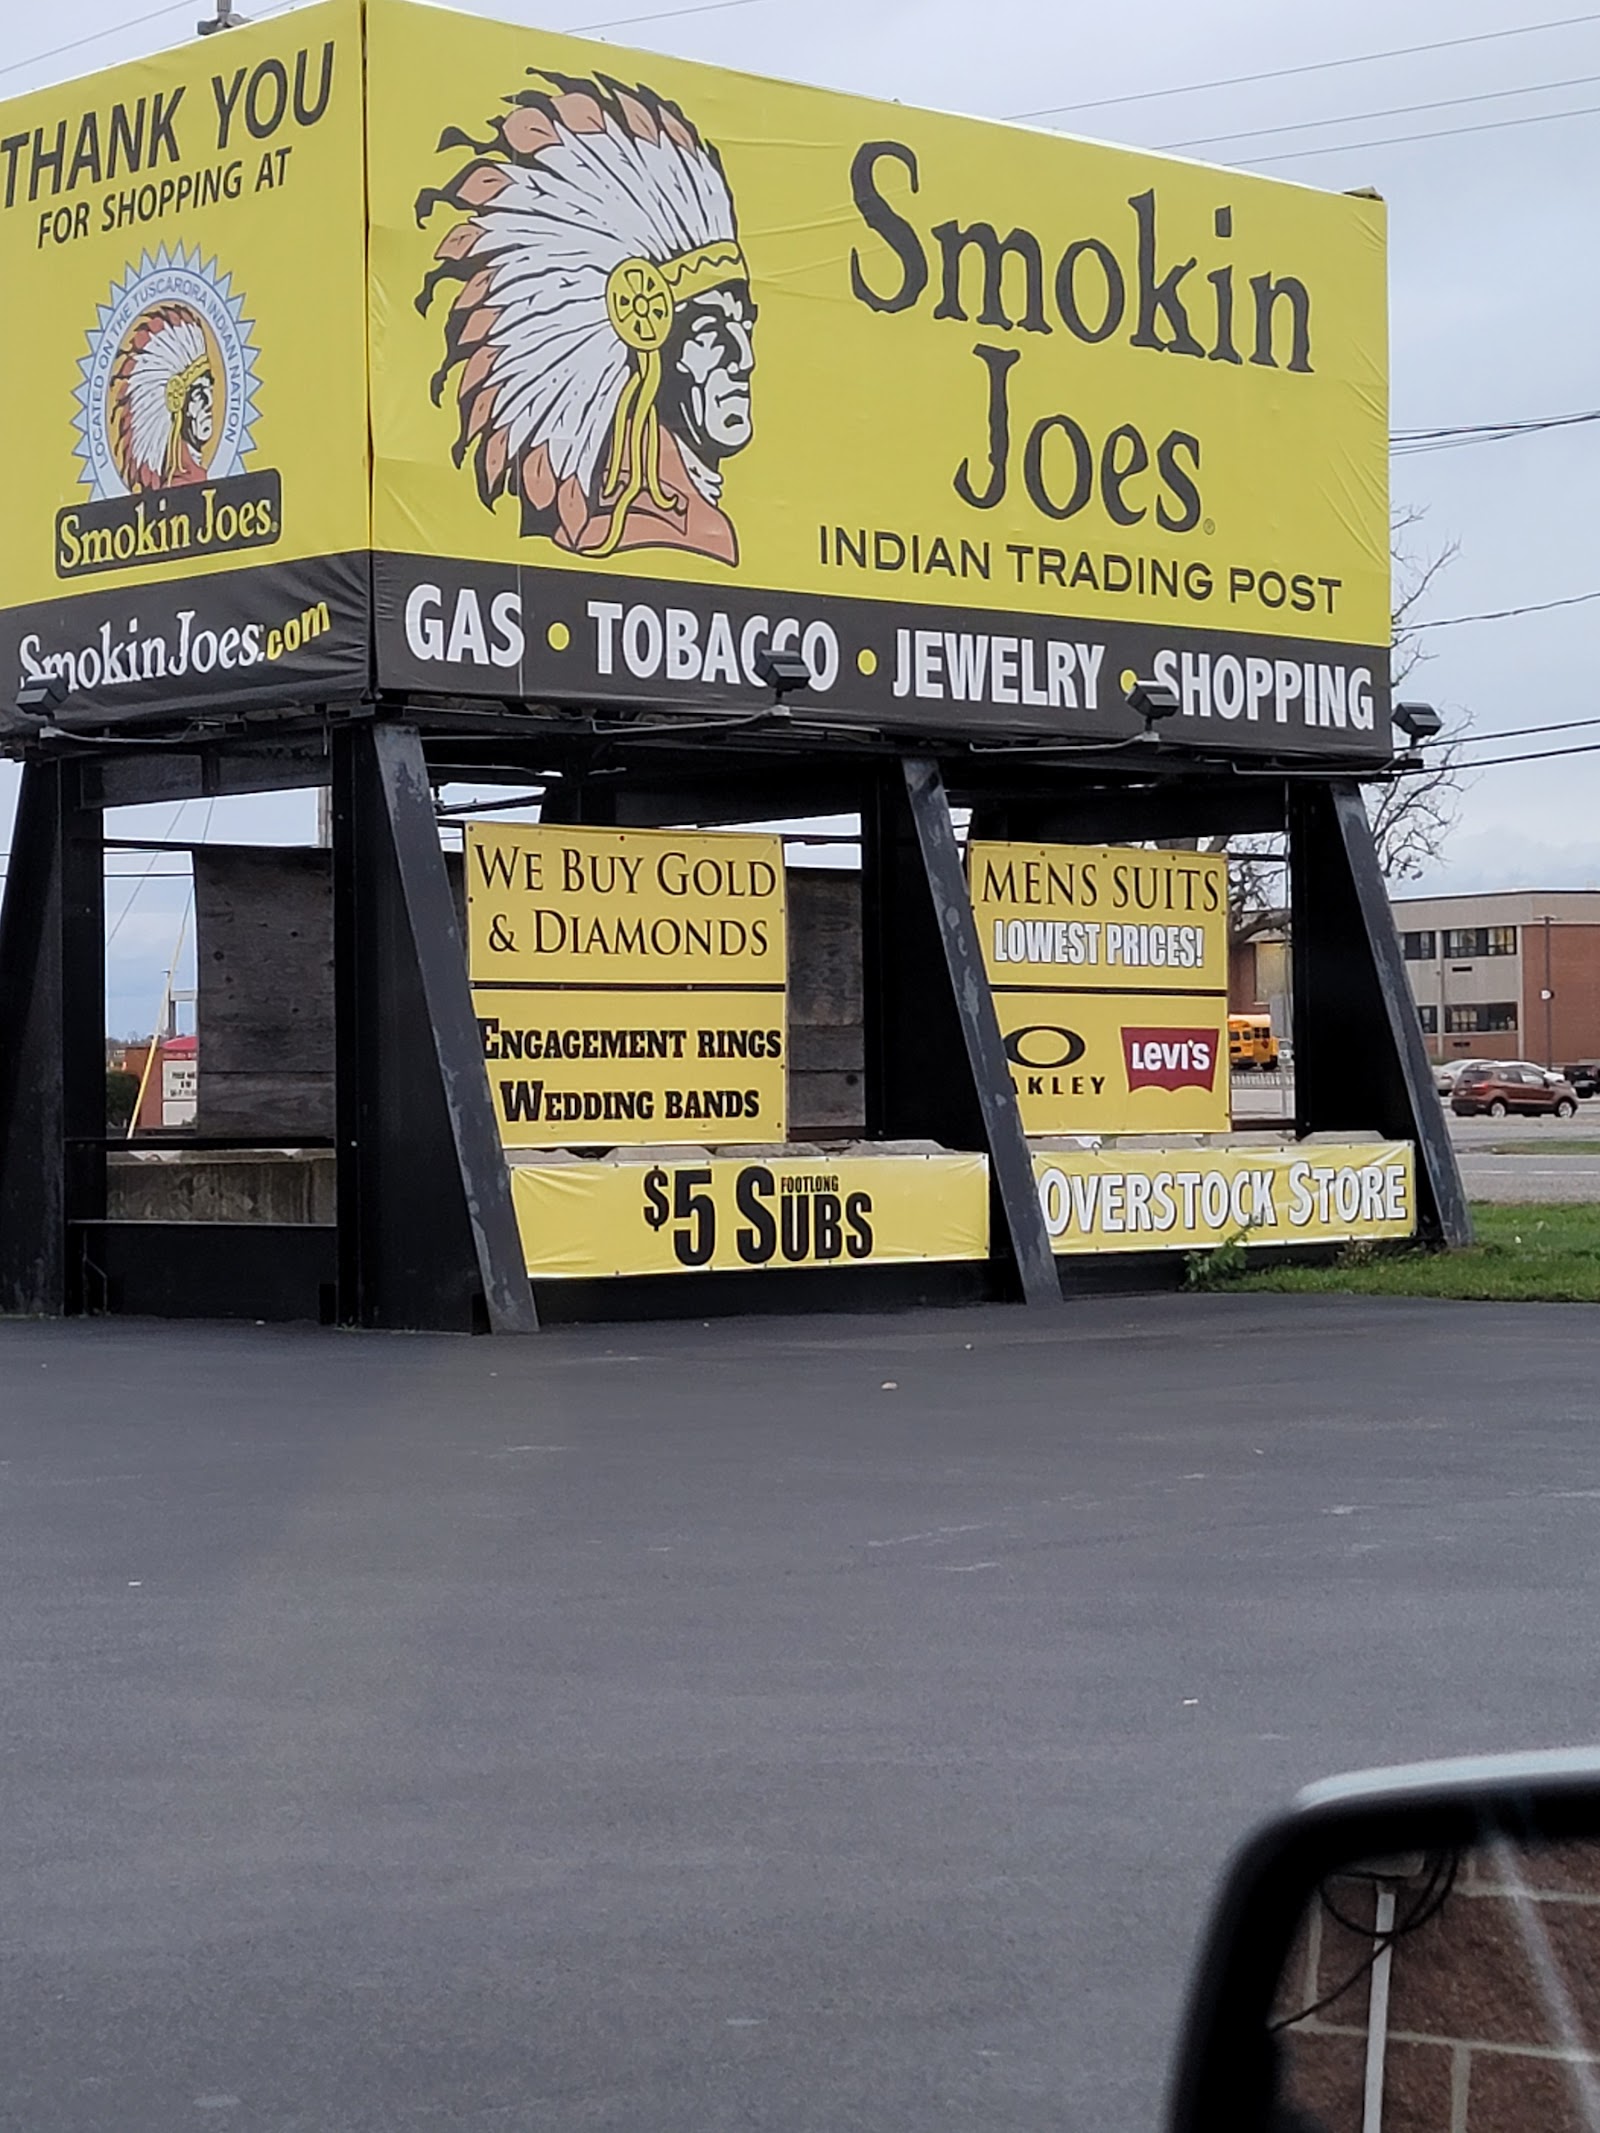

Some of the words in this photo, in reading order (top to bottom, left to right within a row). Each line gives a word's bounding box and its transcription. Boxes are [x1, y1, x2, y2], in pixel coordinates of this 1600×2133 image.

[1, 85, 187, 209] THANK
[211, 40, 335, 150] YOU
[37, 201, 91, 250] FOR
[101, 160, 243, 233] SHOPPING
[254, 146, 293, 193] AT
[850, 140, 1315, 373] Smokin
[112, 303, 135, 339] THE
[132, 276, 208, 310] TUSCARORA
[98, 340, 115, 371] ON
[207, 302, 239, 360] INDIAN
[92, 375, 109, 469] LOCATED
[225, 364, 241, 443] NATION
[953, 343, 1202, 533] Joes
[60, 498, 191, 569] Smokin
[196, 488, 272, 544] Joes
[818, 525, 991, 581] INDIAN
[1006, 543, 1214, 601] TRADING
[1229, 566, 1343, 614] POST
[404, 584, 526, 668] GAS
[893, 628, 1105, 710] JEWELRY
[1153, 650, 1375, 731] SHOPPING
[474, 844, 545, 892] WE
[561, 848, 645, 895] BUY
[656, 851, 778, 898] GOLD
[981, 859, 1098, 907] MENS
[1112, 865, 1220, 912] SUITS
[488, 914, 520, 953] &
[533, 909, 769, 957] DIAMONDS
[993, 918, 1102, 965] LOWEST
[1106, 923, 1205, 968] PRICES!
[477, 1018, 688, 1060] ENGAGEMENT
[697, 1029, 783, 1059] RINGS
[499, 1080, 655, 1122] WEDDING
[665, 1089, 761, 1120] BANDS
[643, 1165, 716, 1267] $5
[736, 1165, 873, 1265] SUBS
[780, 1175, 839, 1194] FOOTLONG
[1038, 1167, 1278, 1237] OVERSTOCK
[1288, 1161, 1408, 1226] STORE
